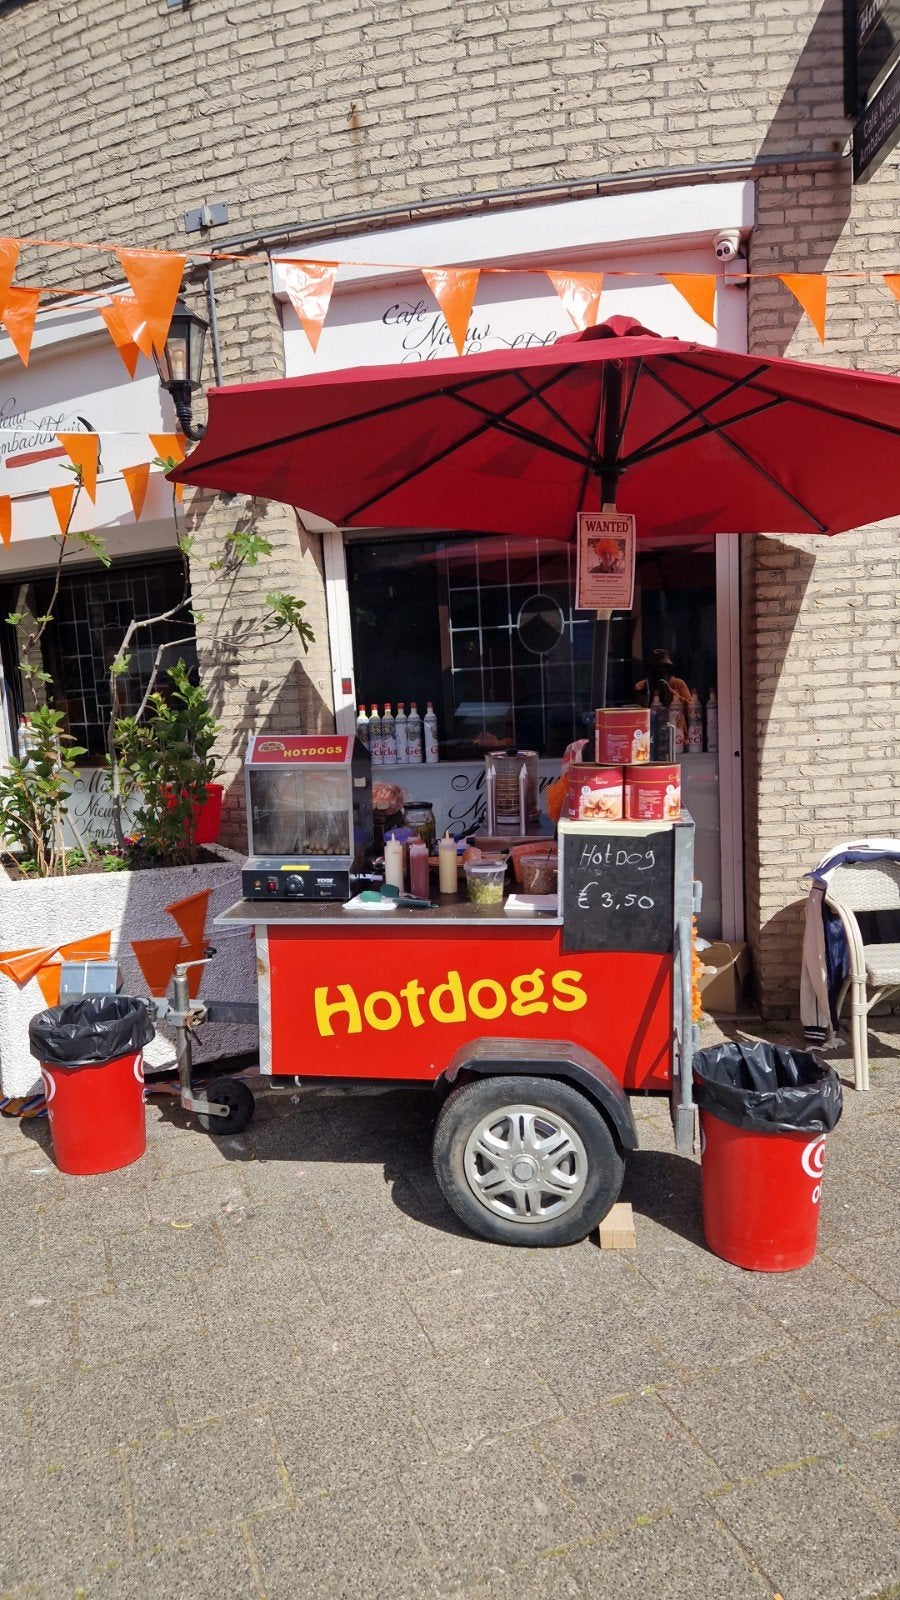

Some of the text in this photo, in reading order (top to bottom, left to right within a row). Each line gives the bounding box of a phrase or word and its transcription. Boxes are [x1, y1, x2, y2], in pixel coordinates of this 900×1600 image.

[585, 520, 629, 533] WANTED
[283, 746, 343, 757] HOTDOGS
[578, 881, 655, 910] € 3,50
[314, 968, 588, 1037] Hotdogs
